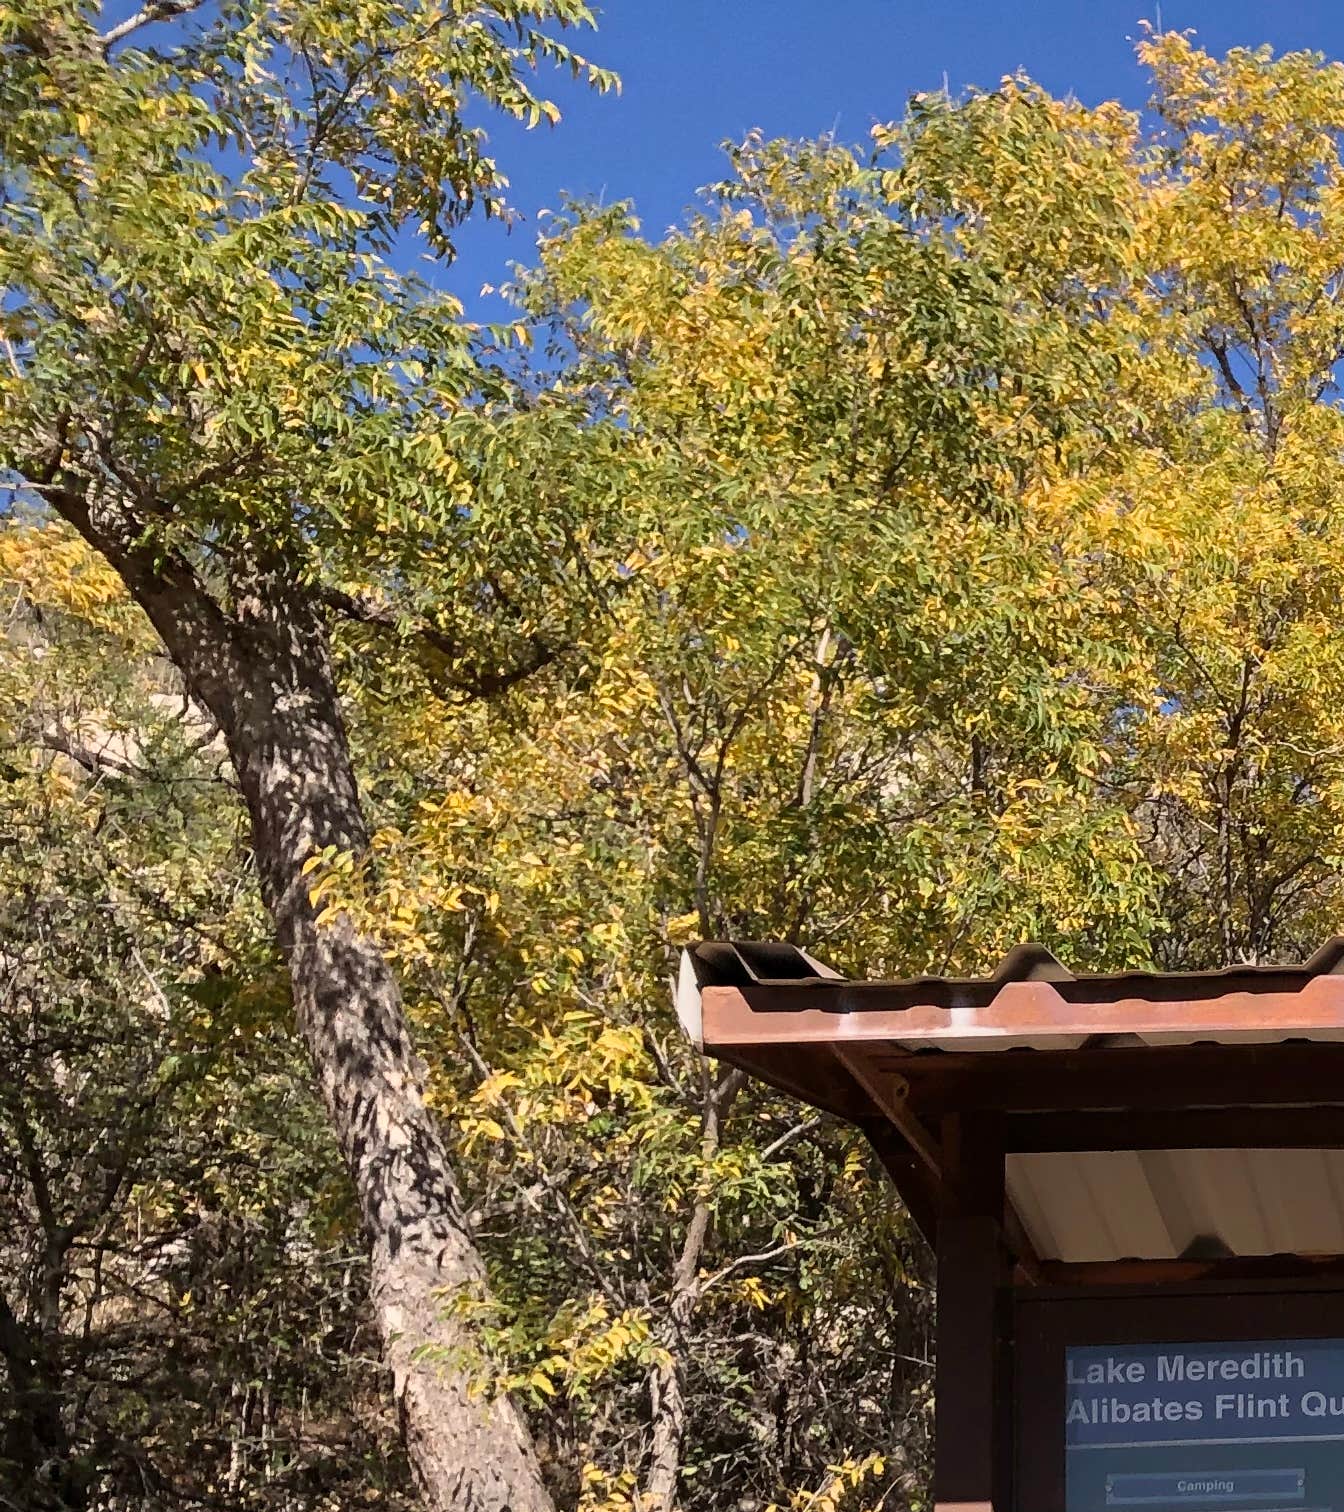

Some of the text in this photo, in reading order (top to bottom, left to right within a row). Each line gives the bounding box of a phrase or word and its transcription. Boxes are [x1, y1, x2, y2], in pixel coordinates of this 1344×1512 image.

[1066, 1352, 1305, 1385] Lake Meredith
[1066, 1397, 1203, 1424] Alibates
[1215, 1392, 1290, 1419] Flint
[1177, 1478, 1234, 1493] Camping
